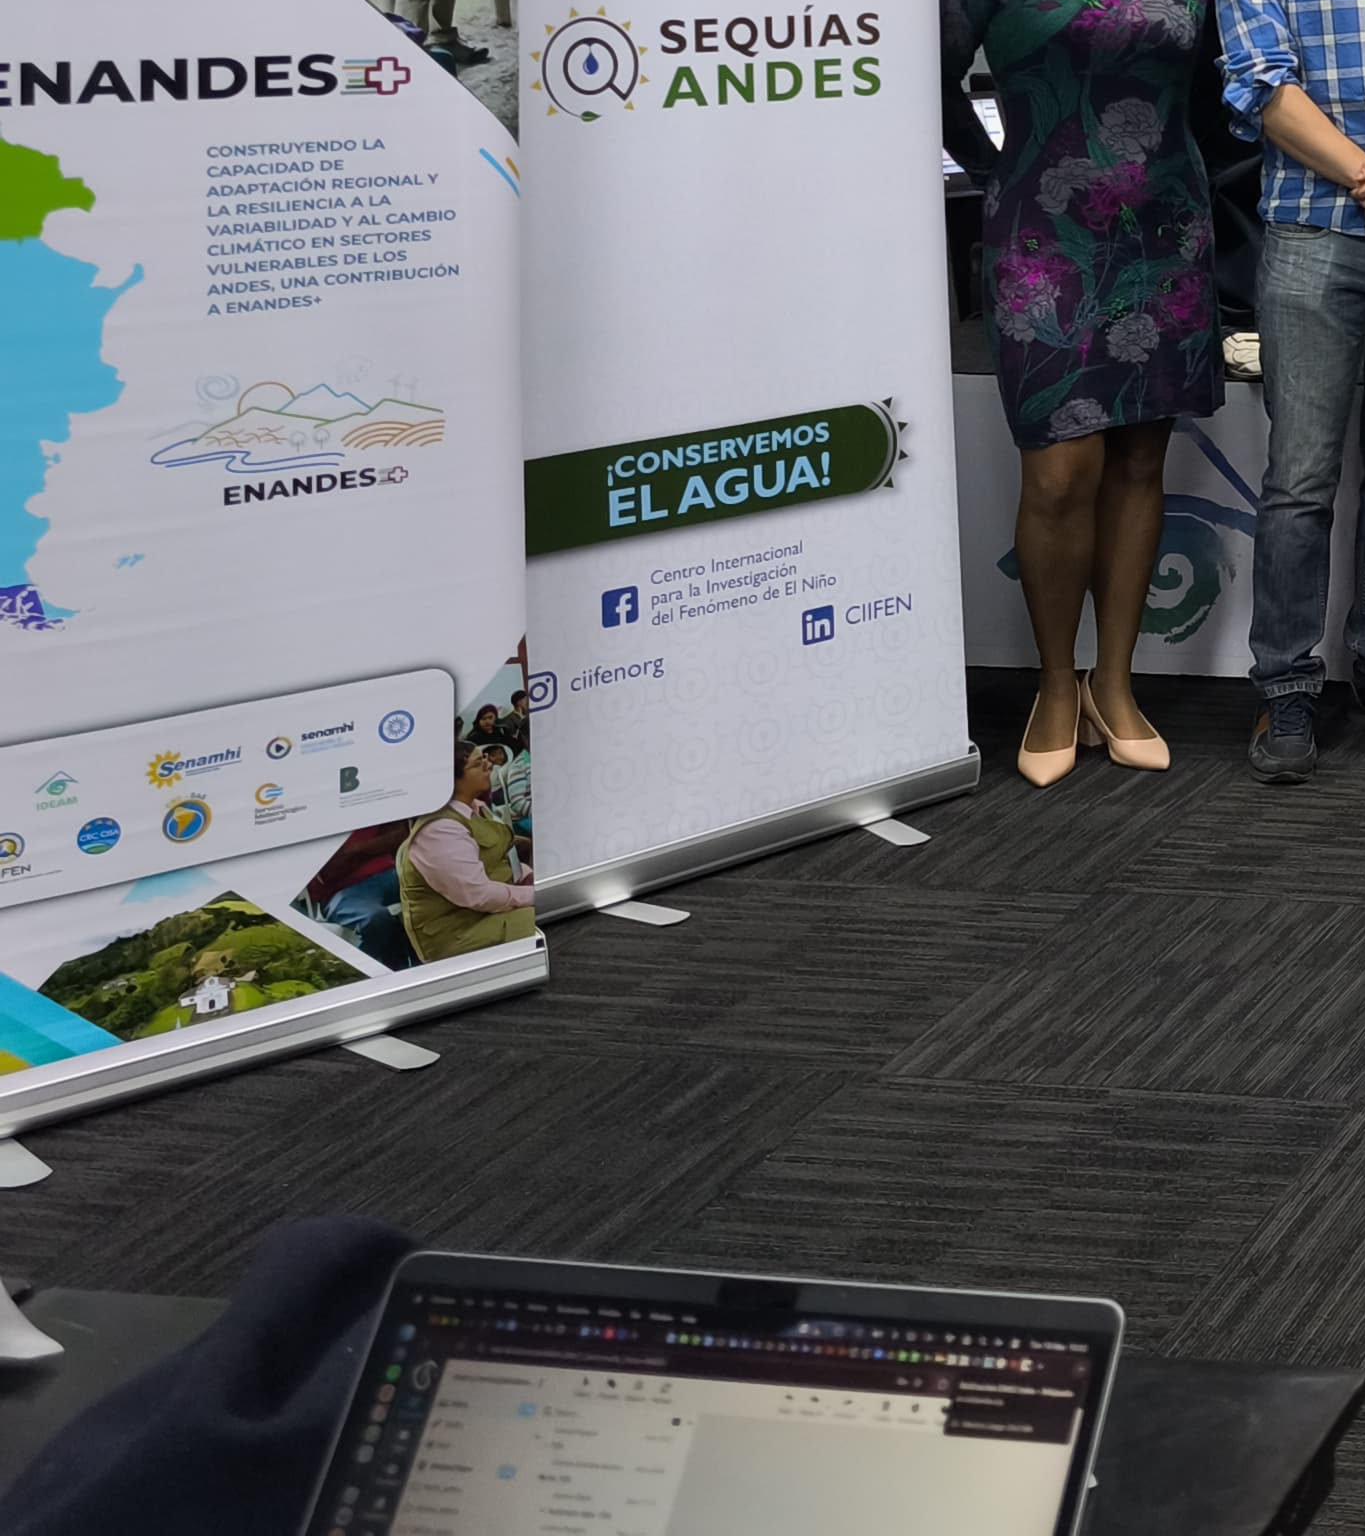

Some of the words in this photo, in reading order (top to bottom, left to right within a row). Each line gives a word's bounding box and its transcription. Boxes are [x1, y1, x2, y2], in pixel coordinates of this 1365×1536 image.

[660, 5, 880, 58] SEQUÍAS
[662, 56, 881, 109] ANDES
[206, 140, 357, 158] CONSTRUYENDO
[362, 138, 386, 151] LA
[206, 161, 314, 178] CAPACIDAD
[320, 159, 345, 172] DE
[206, 178, 325, 198] ADAPTACIÓN
[332, 174, 423, 190] REGIONAL
[427, 172, 439, 185] Y
[207, 204, 231, 218] LA
[236, 196, 346, 216] RESILIENCIA
[350, 196, 364, 208] A
[369, 194, 392, 207] LA
[206, 216, 337, 237] VARIABILIDAD
[341, 215, 354, 228] Y
[358, 214, 382, 227] AL
[386, 209, 456, 225] CAMBIO
[207, 238, 306, 257] CLIMÁTICO
[311, 235, 335, 249] EN
[339, 229, 432, 247] SECTORES
[206, 254, 339, 276] VULNERABLES
[343, 252, 368, 266] DE
[373, 249, 408, 263] LOS
[207, 279, 276, 297] ANDES,
[280, 275, 319, 290] UNA
[323, 263, 460, 286] CONTRIBUCIÓN
[207, 303, 221, 316] A
[226, 295, 322, 314] ENANDES+
[607, 422, 830, 487] ¡CONSERVEMOS
[608, 486, 668, 527] EL
[677, 452, 831, 515] AGUA!
[650, 565, 706, 585] Centro
[711, 540, 804, 574] Internacional
[651, 589, 683, 610] para
[689, 583, 701, 598] la
[706, 563, 798, 594] Investigación
[651, 607, 674, 627] del
[680, 592, 758, 620] Fenómeno
[762, 585, 781, 601] de
[785, 581, 797, 596] El
[802, 573, 838, 592] Niño
[845, 593, 913, 626] CIIFEN
[570, 657, 666, 692] ciifenorg
[301, 721, 354, 741] senamhi
[158, 745, 242, 778] Senamhi
[36, 796, 78, 813] IDEAM
[0, 864, 31, 879] FEN
